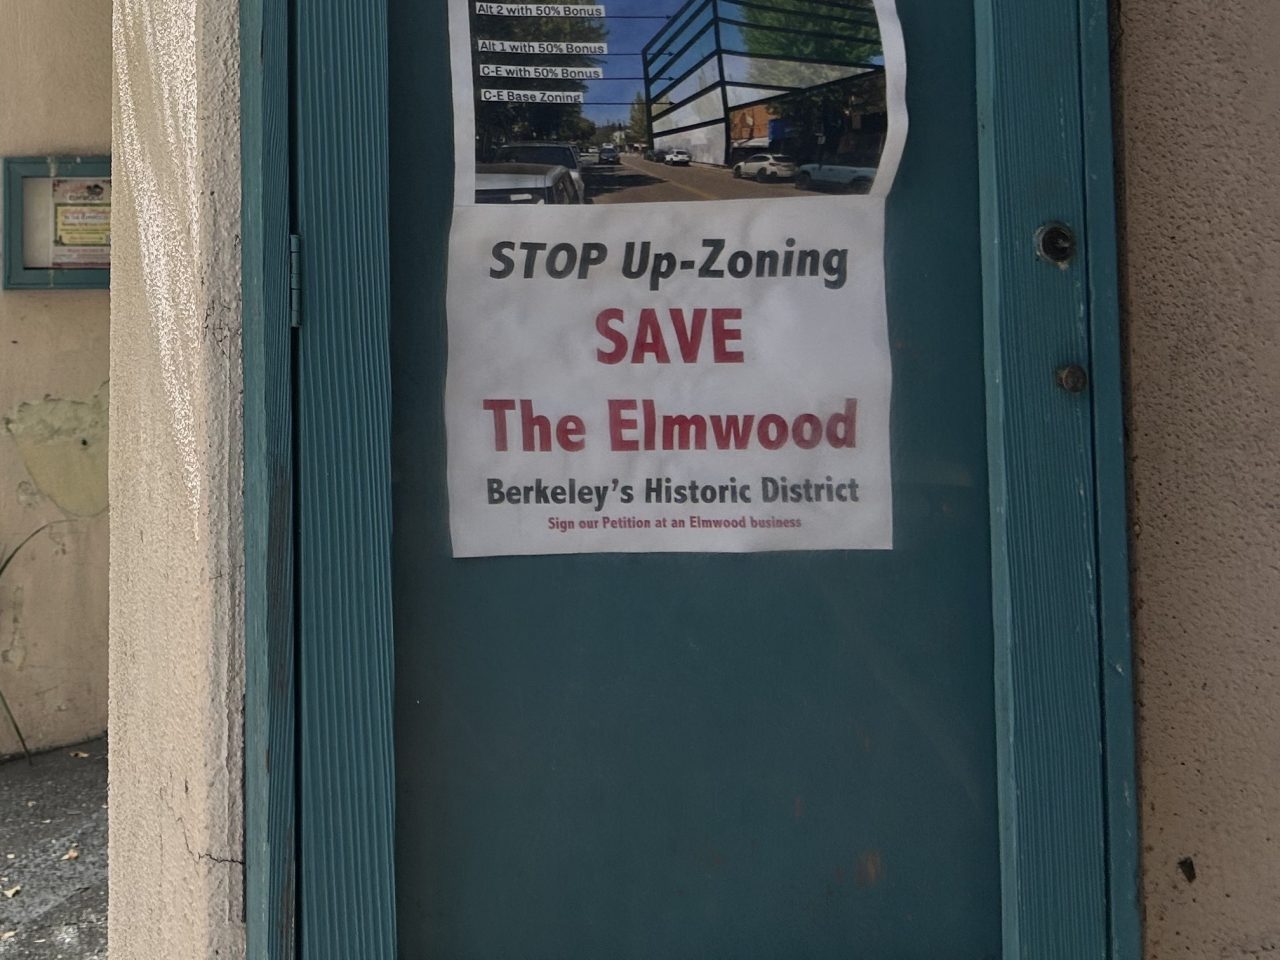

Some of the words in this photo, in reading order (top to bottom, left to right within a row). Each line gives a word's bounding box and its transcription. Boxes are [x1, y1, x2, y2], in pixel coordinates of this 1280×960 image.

[478, 4, 493, 14] Alt
[496, 5, 503, 14] 2
[506, 5, 532, 15] with
[536, 6, 560, 16] 50%
[564, 7, 602, 17] Bonus
[480, 41, 496, 51] Alt
[500, 42, 506, 51] 1
[509, 43, 534, 53] with
[538, 43, 563, 53] 50%
[566, 44, 604, 54] Bonus
[482, 66, 502, 76] C-E
[505, 67, 530, 77] with
[534, 68, 558, 78] 50%
[561, 69, 600, 79] Bonus
[483, 90, 504, 100] C-E
[507, 91, 536, 101] Base
[540, 92, 581, 103] Zoning
[489, 241, 608, 279] STOP
[621, 238, 849, 290] Up-Zoning
[595, 307, 745, 365] SAVE
[483, 399, 586, 452] The
[608, 398, 858, 451] Elmwood
[486, 477, 634, 512] Berkeley's
[645, 477, 751, 504] Historic
[761, 476, 859, 503] District
[548, 516, 575, 531] Sign
[578, 519, 599, 529] our
[602, 516, 651, 529] Petition
[655, 517, 668, 529] at
[670, 518, 686, 529] an
[689, 516, 746, 529] Elmwood
[750, 516, 802, 529] business
